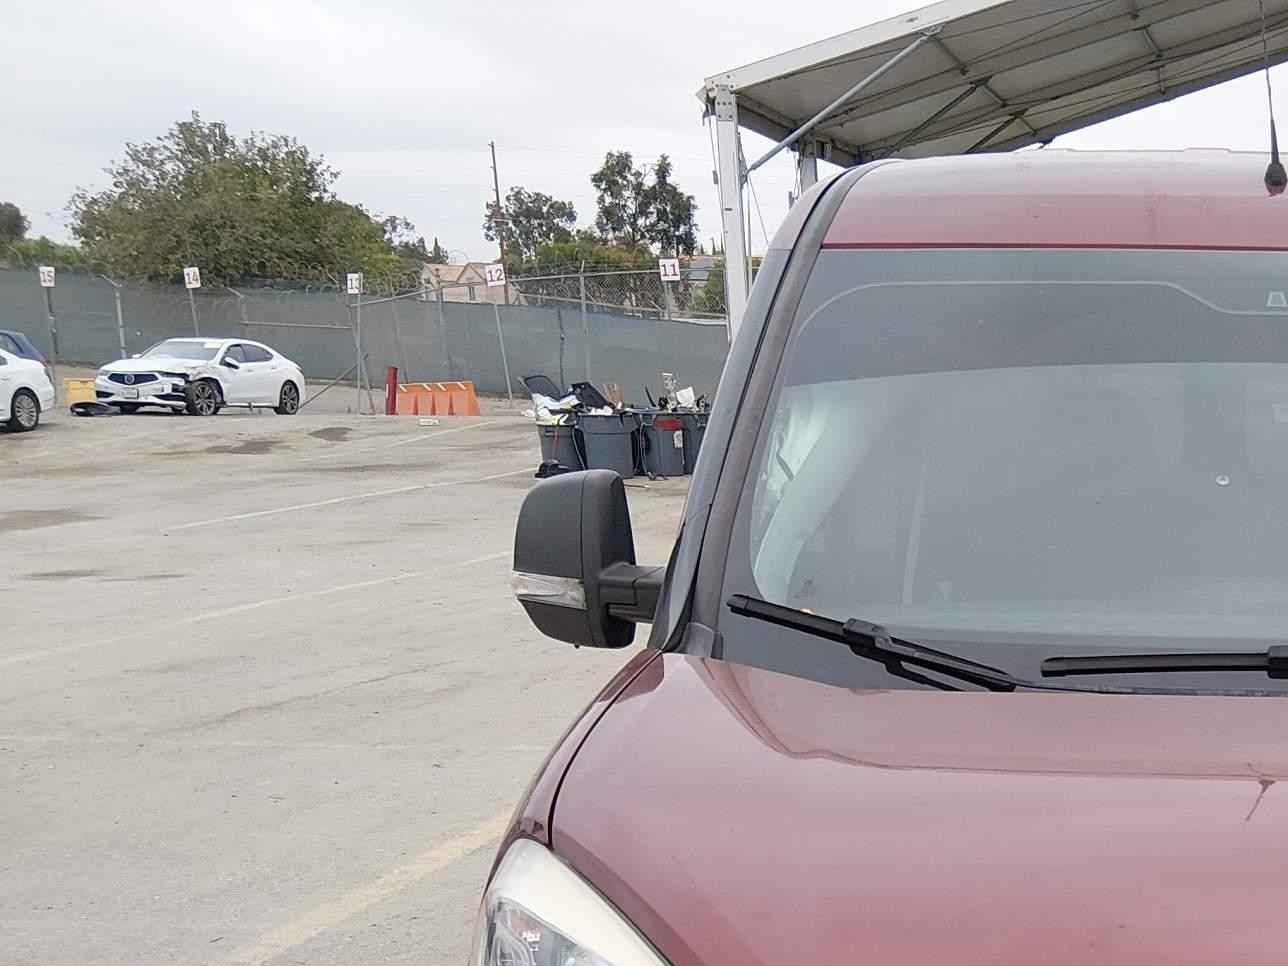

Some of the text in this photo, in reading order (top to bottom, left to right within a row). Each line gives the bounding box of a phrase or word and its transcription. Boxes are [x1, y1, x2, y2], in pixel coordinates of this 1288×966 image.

[41, 270, 54, 282] 15
[487, 268, 504, 282] 12
[661, 263, 679, 276] 11
[186, 271, 199, 284] 14
